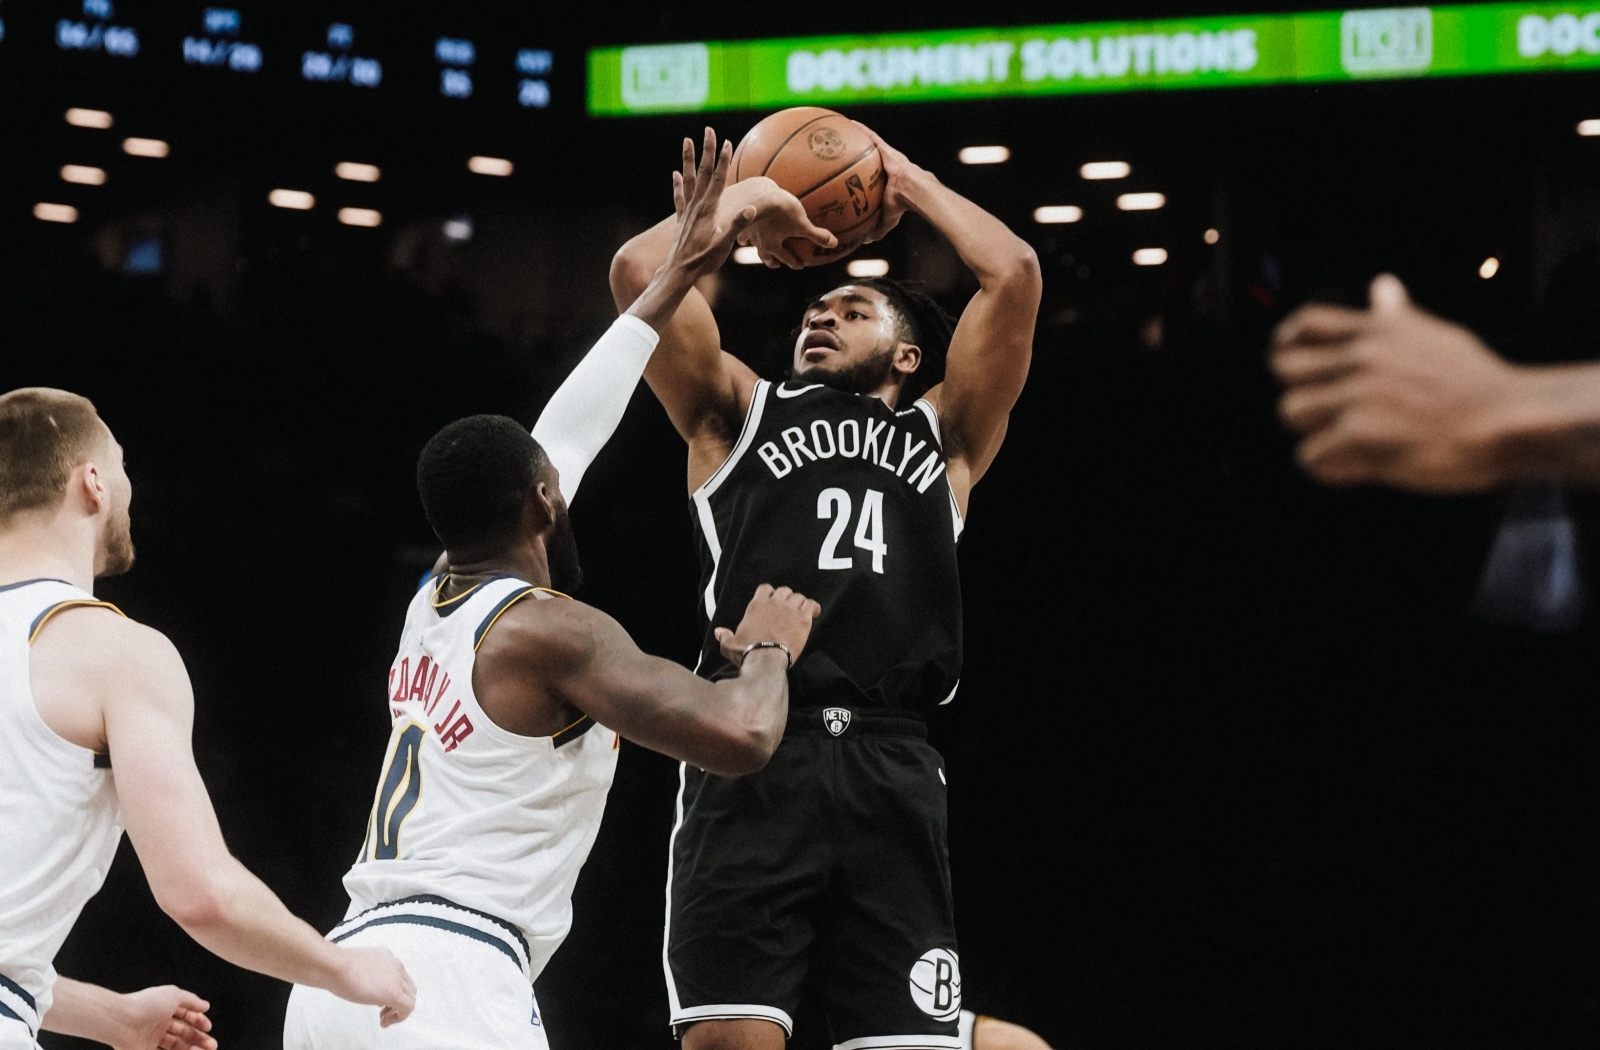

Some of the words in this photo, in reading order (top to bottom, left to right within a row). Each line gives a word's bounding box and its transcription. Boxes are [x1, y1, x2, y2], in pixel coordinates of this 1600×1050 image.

[787, 42, 1012, 93] DOCUMENT
[1022, 29, 1256, 80] SOLUTIONS
[757, 417, 945, 494] BROOKLYN
[816, 487, 888, 574] 24
[434, 699, 474, 753] JR
[826, 711, 849, 722] NETS
[933, 957, 953, 1011] B
